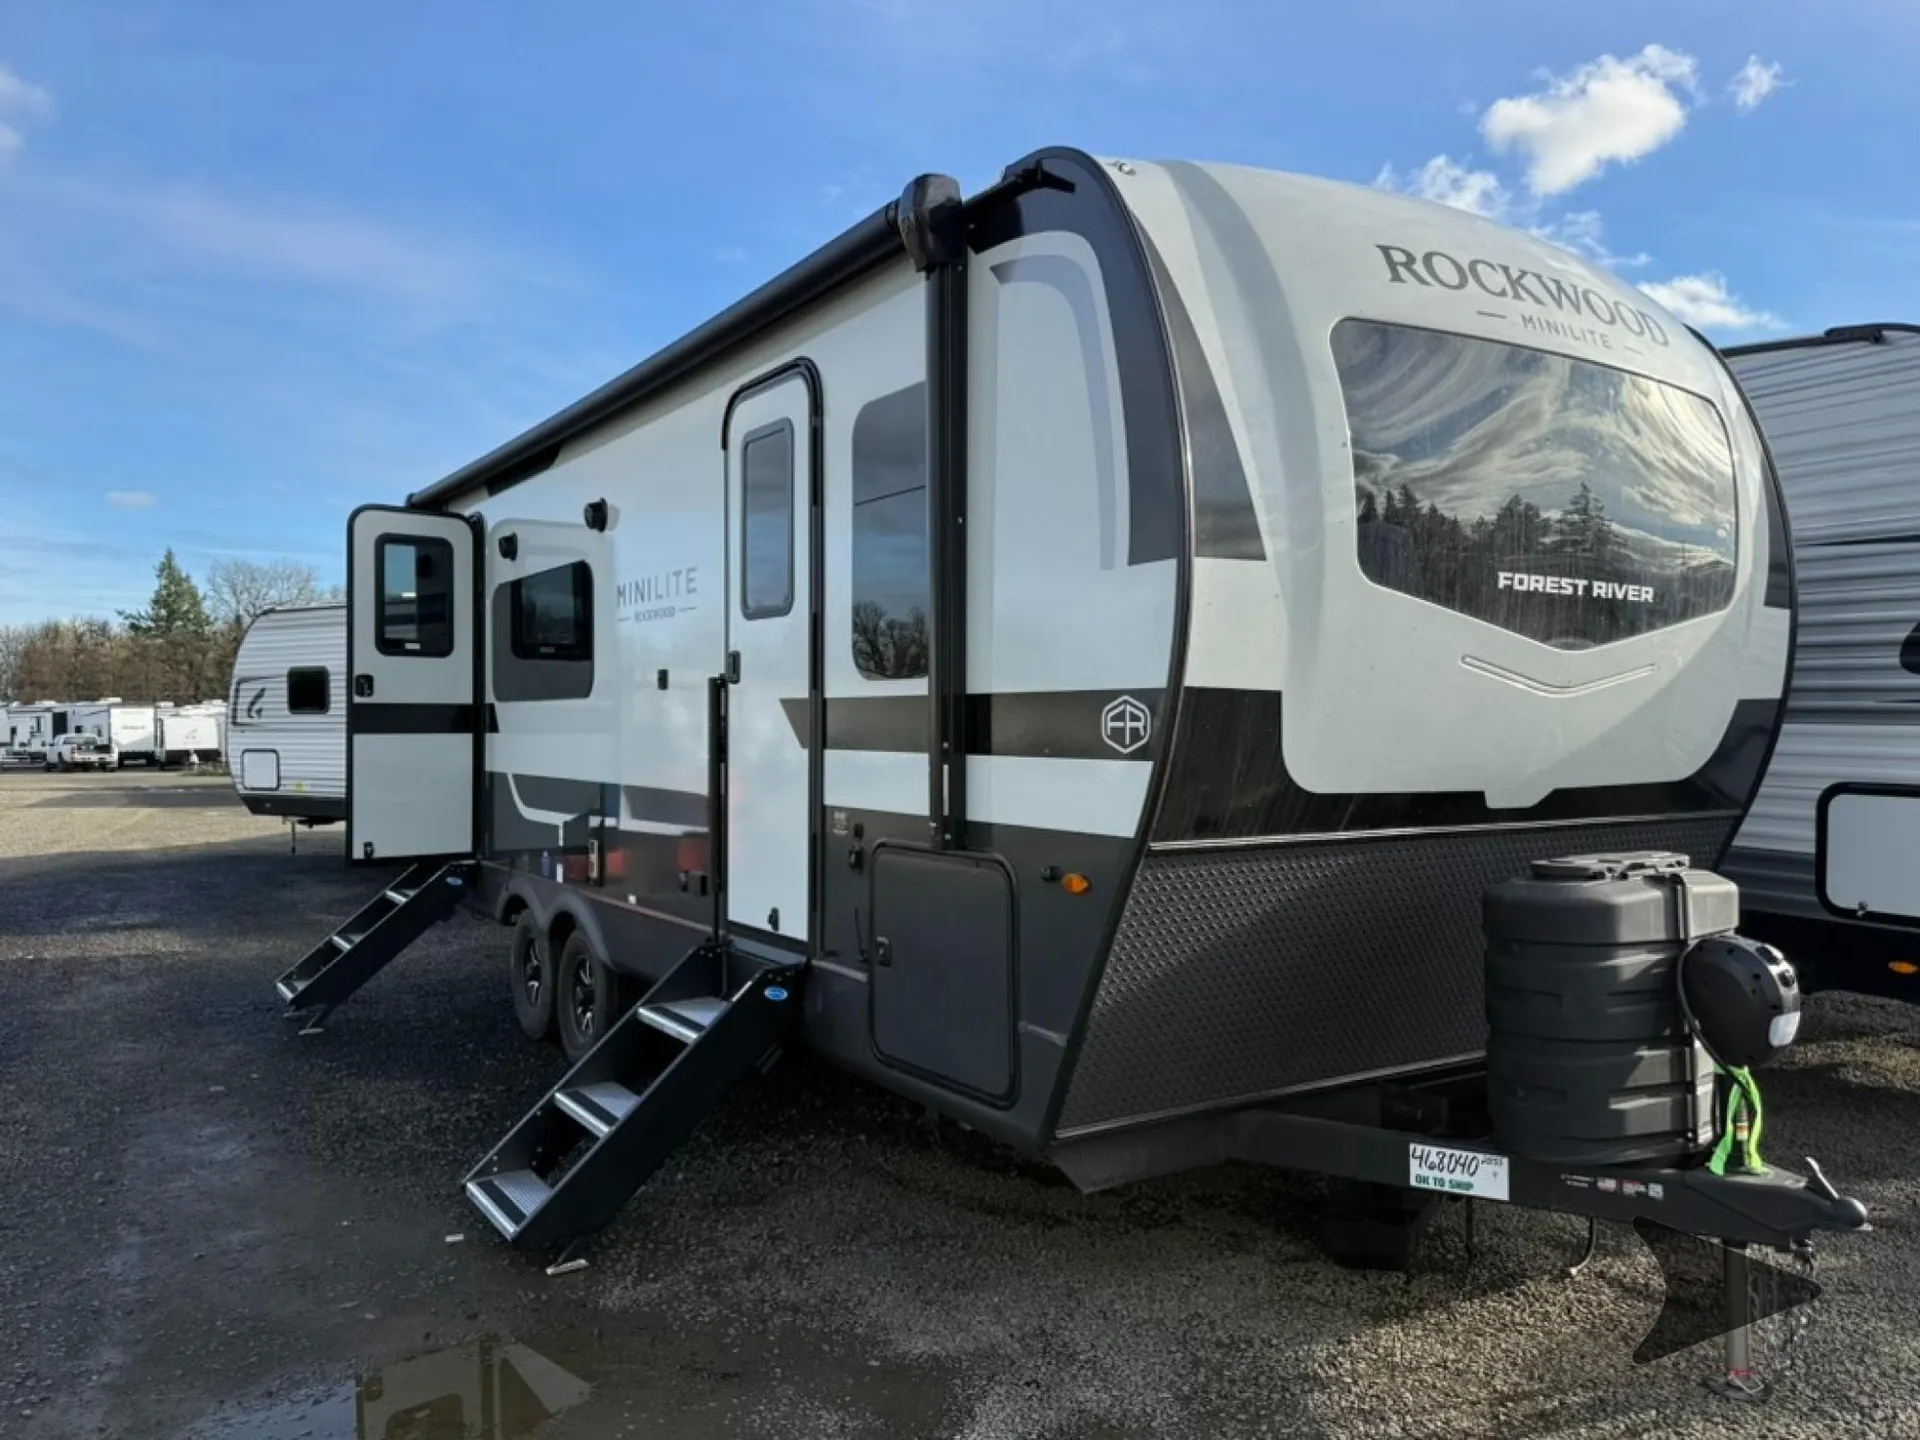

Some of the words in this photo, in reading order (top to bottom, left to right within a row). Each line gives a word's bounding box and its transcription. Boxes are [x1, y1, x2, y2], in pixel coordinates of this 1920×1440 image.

[1375, 243, 1669, 347] ROCKWOOD
[1521, 313, 1613, 350] MINILITE
[616, 565, 698, 608] MINILITE
[1498, 571, 1588, 596] FOREST
[1592, 580, 1654, 602] RIVER
[1411, 1145, 1480, 1177] 468040
[1415, 1173, 1430, 1186] OK
[1432, 1176, 1445, 1188] TO
